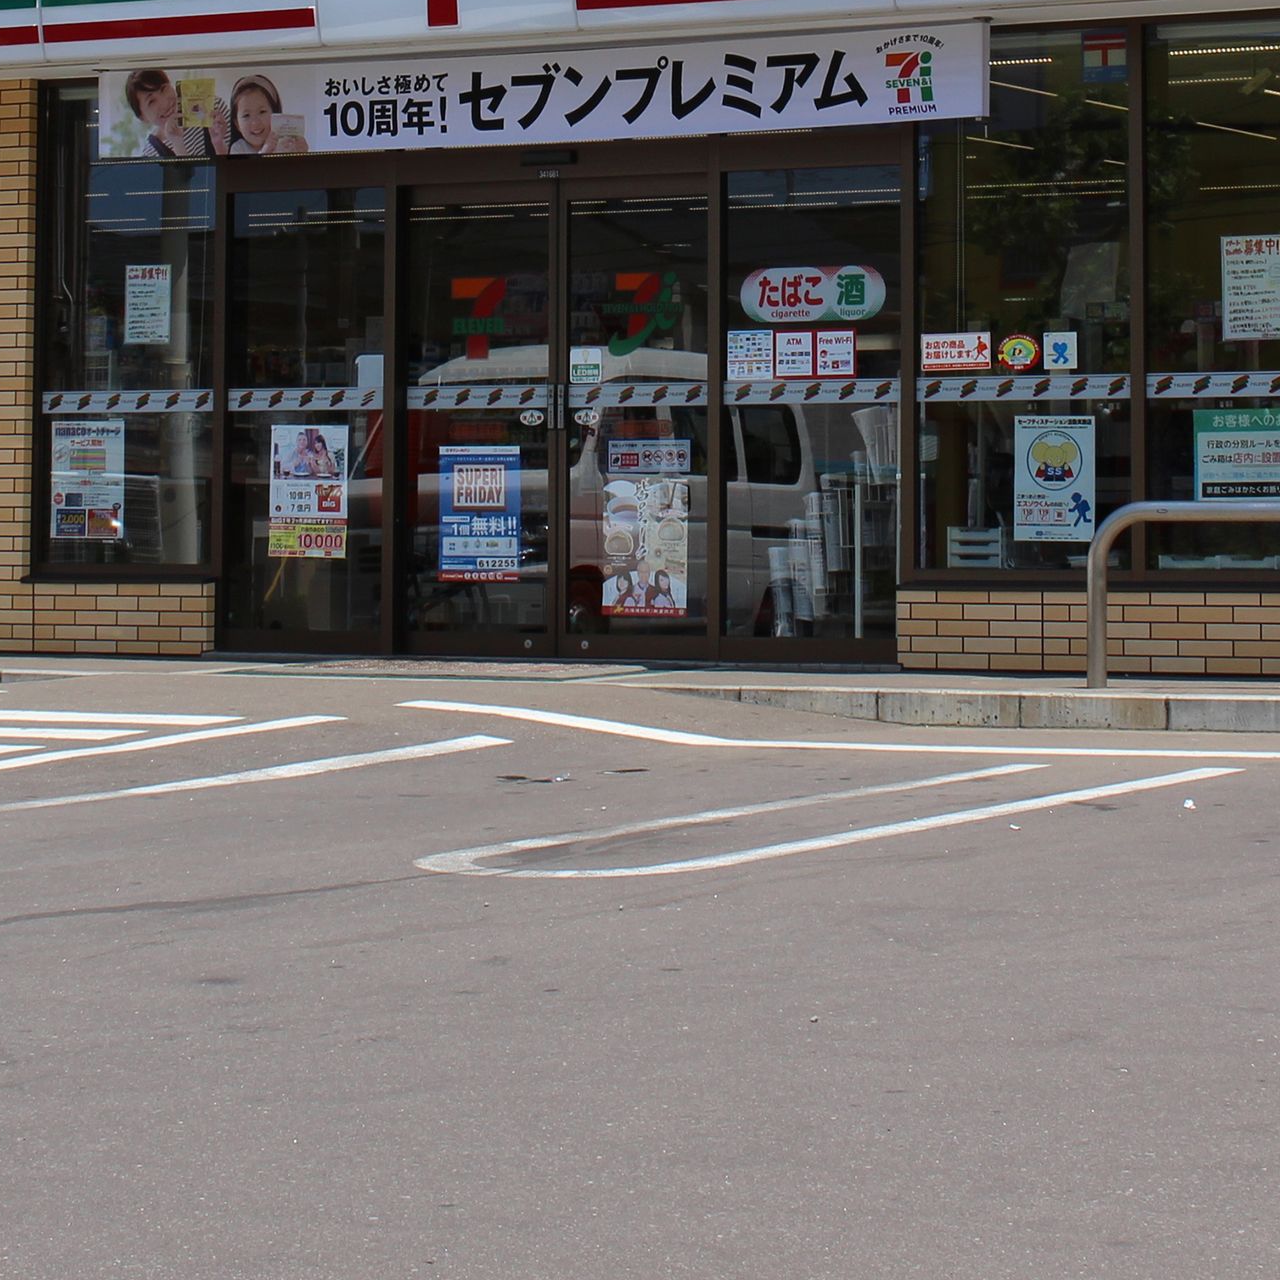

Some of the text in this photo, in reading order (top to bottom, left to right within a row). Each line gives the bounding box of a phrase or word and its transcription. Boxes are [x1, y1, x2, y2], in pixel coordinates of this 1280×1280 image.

[324, 72, 449, 97] おいしさ極めて
[458, 49, 869, 131] セブンプレミアム
[323, 95, 448, 137] 10周年!
[888, 104, 937, 115] PREMIUM
[758, 273, 866, 308] たばこ 酒
[770, 308, 866, 319] cigarette liquor
[785, 338, 803, 346] ATM
[818, 337, 834, 346] Free
[925, 340, 966, 349] お店の商品
[457, 487, 502, 503] FRIDAY
[451, 523, 470, 536] 1個
[471, 516, 517, 536] 無料!!
[478, 560, 516, 568] 612255
